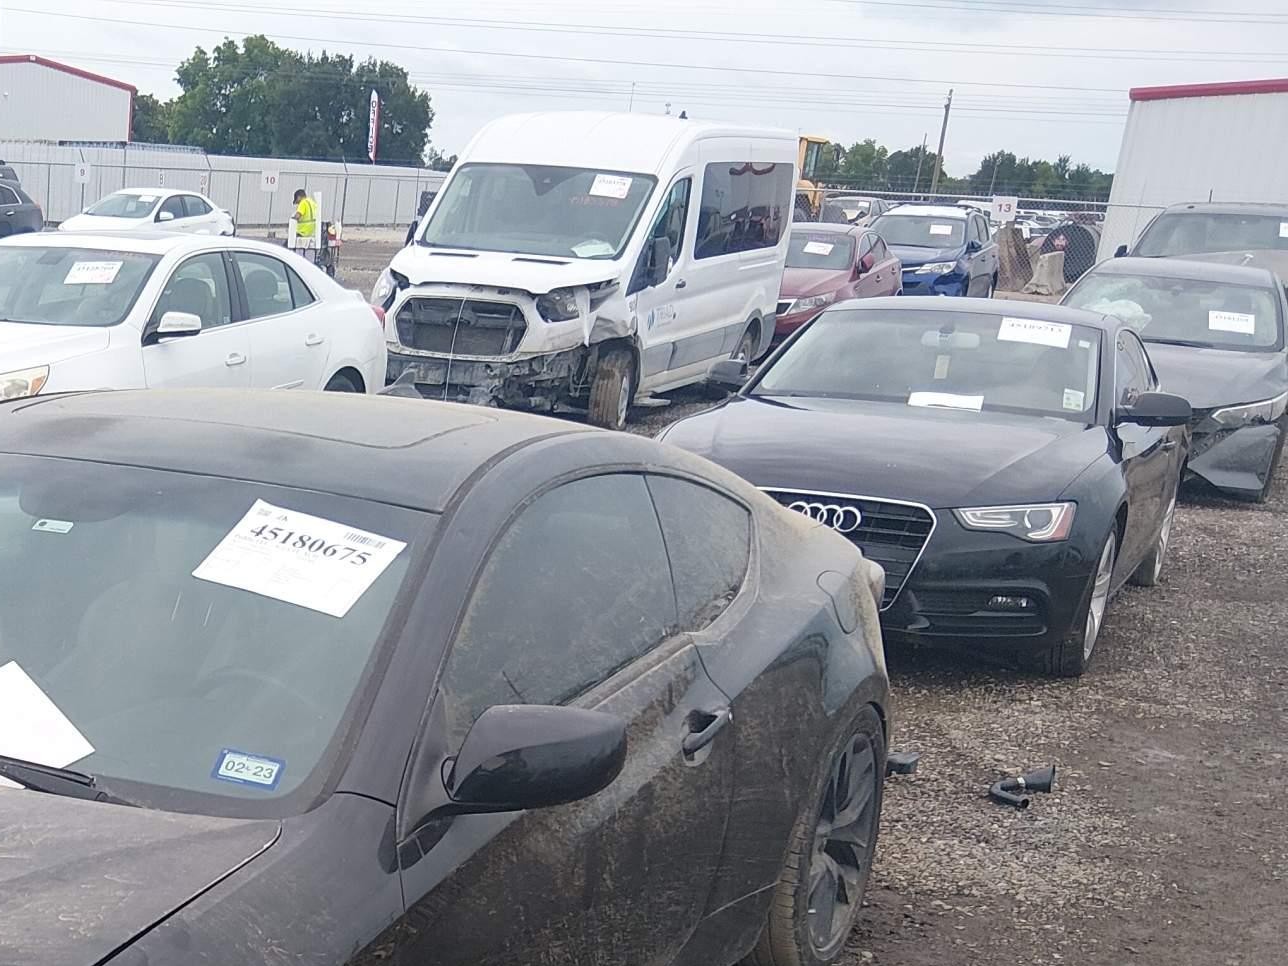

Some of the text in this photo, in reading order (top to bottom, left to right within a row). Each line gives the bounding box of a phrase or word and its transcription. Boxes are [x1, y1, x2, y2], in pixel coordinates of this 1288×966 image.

[79, 168, 86, 177] 9
[265, 176, 276, 185] 10
[997, 203, 1012, 213] 13
[250, 524, 372, 566] 45180675
